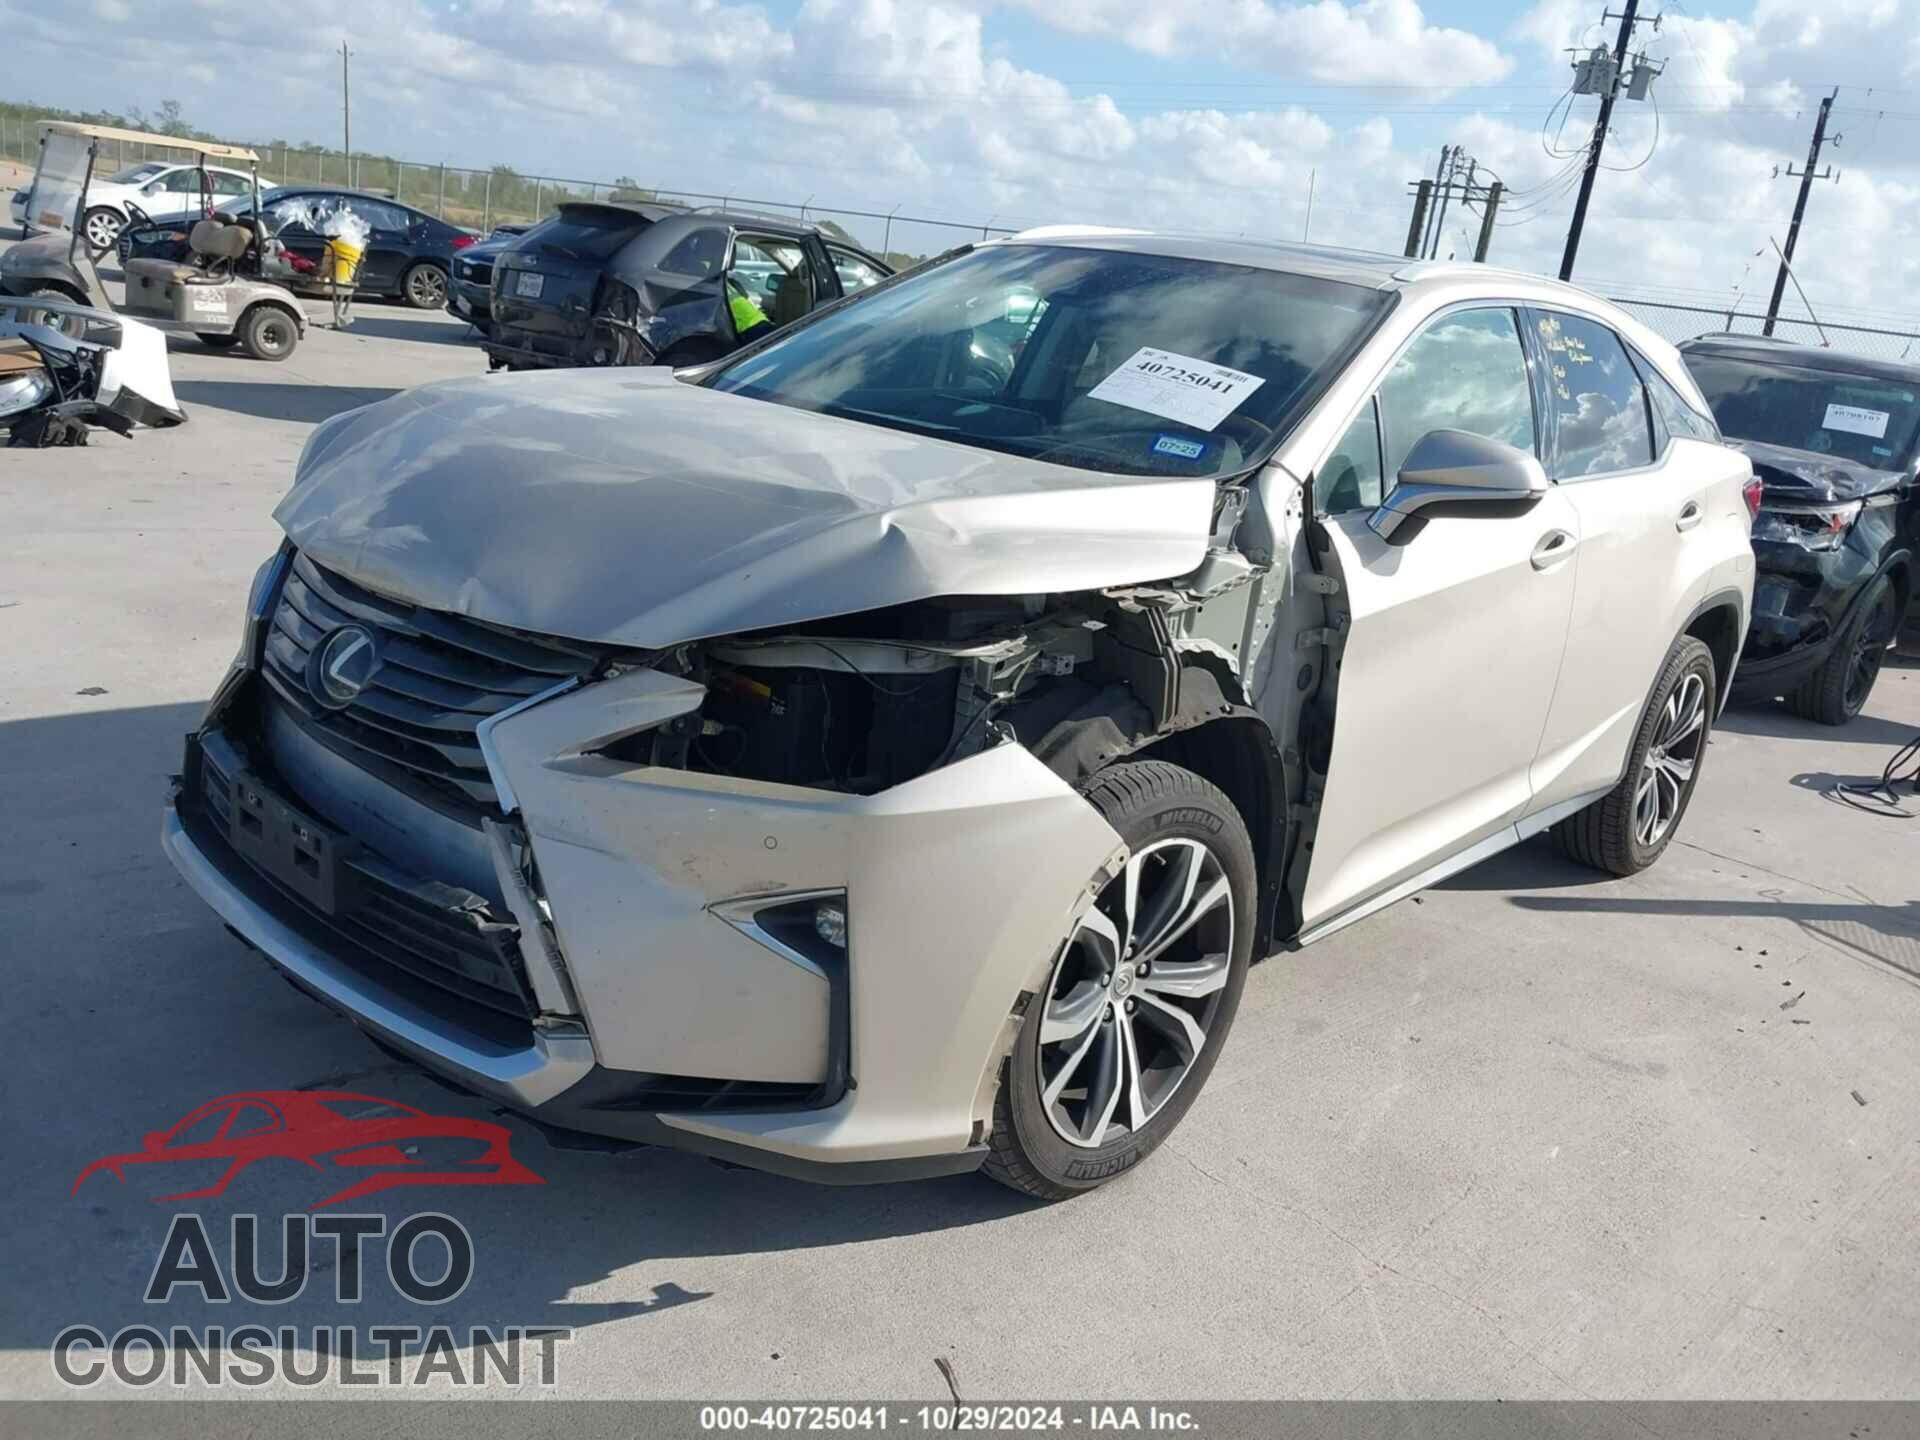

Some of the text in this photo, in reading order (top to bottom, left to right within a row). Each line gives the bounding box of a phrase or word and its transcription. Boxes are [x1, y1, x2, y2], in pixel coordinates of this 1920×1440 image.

[1136, 361, 1234, 394] 40725041
[1159, 441, 1198, 455] 07-25
[1160, 808, 1222, 833] MICHELIN
[1066, 1149, 1137, 1178] MICHELIN
